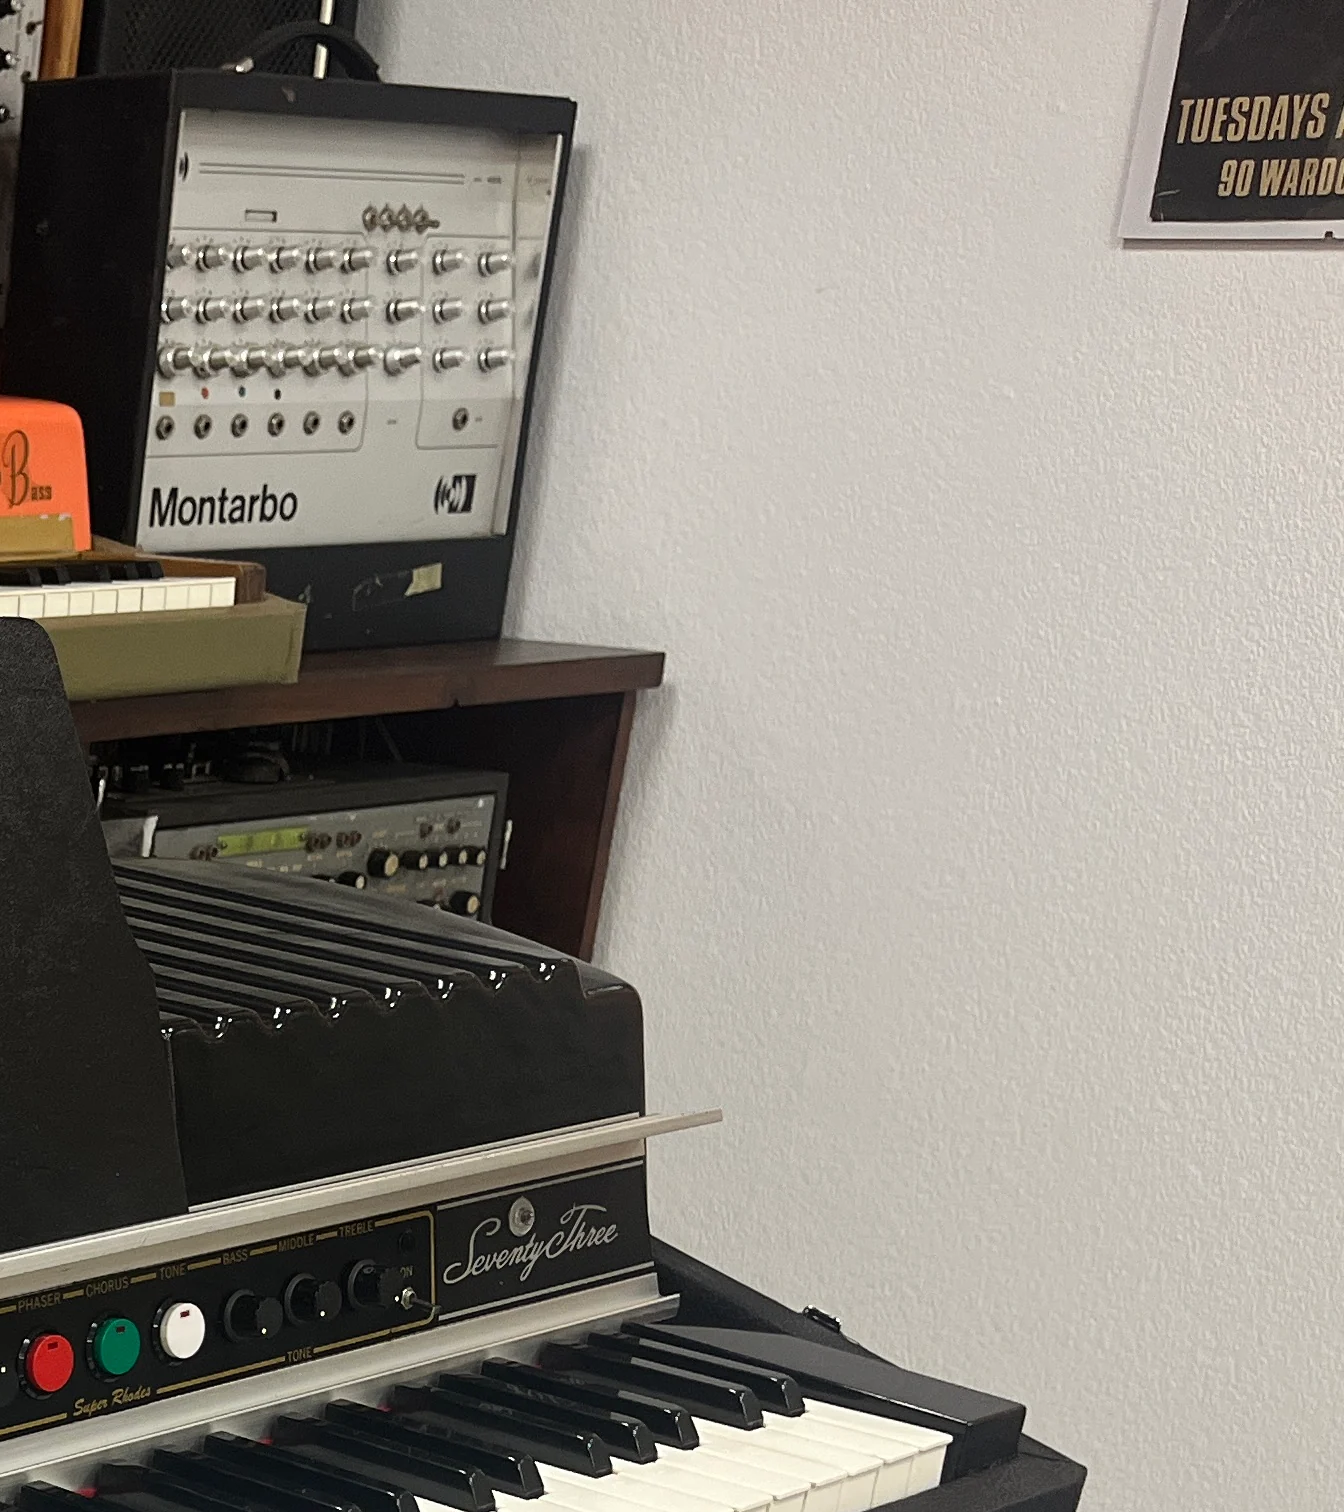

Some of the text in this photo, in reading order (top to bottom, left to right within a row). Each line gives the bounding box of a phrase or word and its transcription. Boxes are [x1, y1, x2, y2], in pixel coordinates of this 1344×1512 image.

[1177, 93, 1330, 144] TUESDAYS
[1218, 159, 1255, 197] 90
[2, 430, 52, 509] Bass
[149, 484, 298, 528] Montarbo
[339, 1219, 374, 1238] TREBLE
[278, 1233, 315, 1252] MIDDLE
[442, 1202, 619, 1284] Seventy Three
[222, 1249, 248, 1265] BASS
[159, 1263, 186, 1280] TONE
[86, 1277, 129, 1298] CHORUS
[17, 1292, 62, 1313] PHASER
[286, 1347, 313, 1363] TONE
[73, 1385, 151, 1418] Super Rhodes
